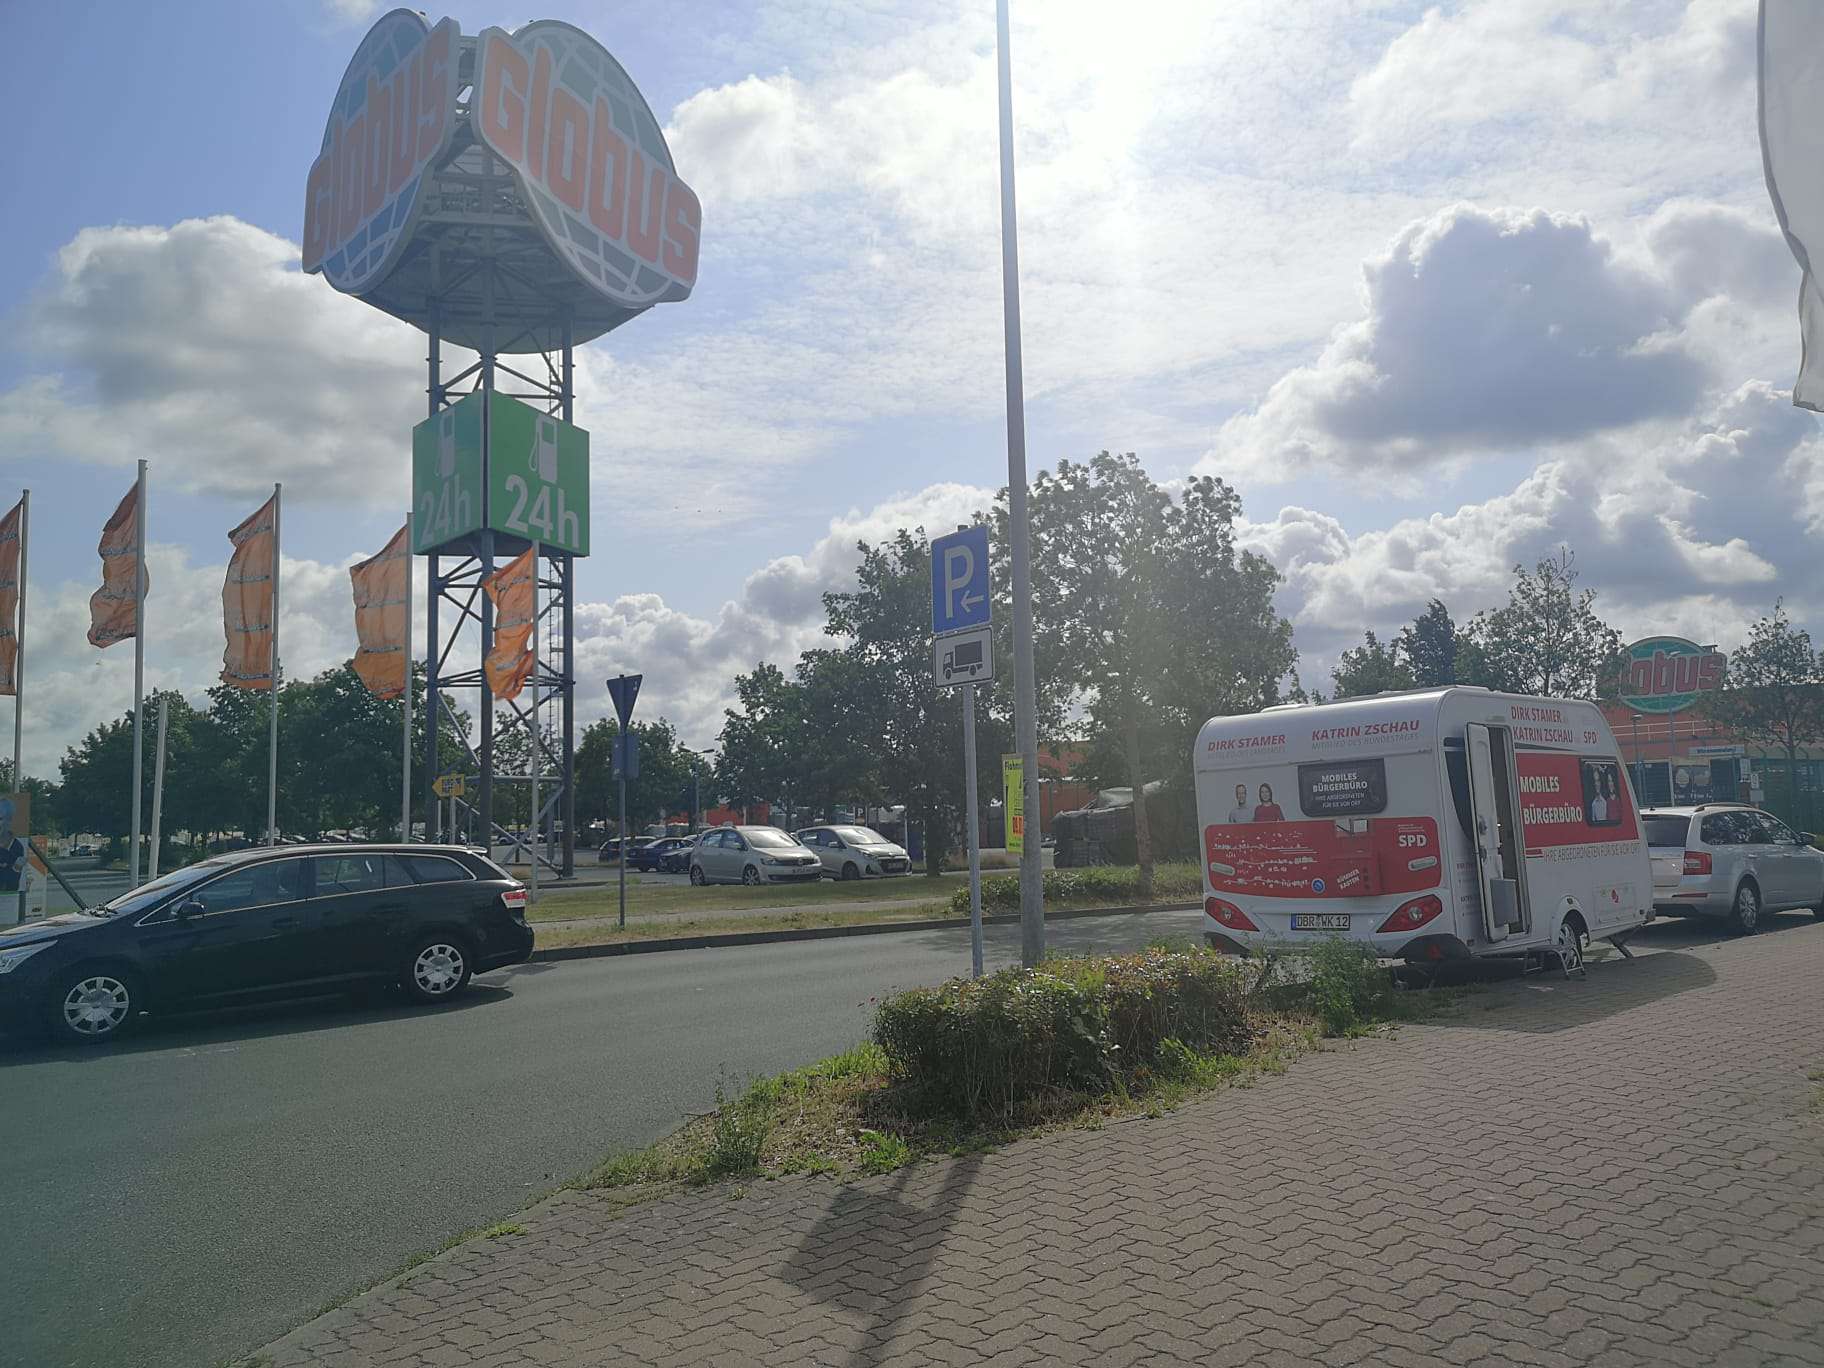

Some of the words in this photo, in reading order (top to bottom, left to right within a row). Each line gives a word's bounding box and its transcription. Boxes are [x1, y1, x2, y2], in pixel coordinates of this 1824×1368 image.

[304, 28, 450, 266] Globus
[484, 35, 696, 289] Globus
[420, 473, 472, 546] 24h
[505, 474, 579, 548] 24h
[944, 545, 974, 619] P
[1511, 705, 1530, 720] DIRK
[1532, 707, 1562, 723] STAMER
[1312, 726, 1361, 741] KATRIN
[1364, 720, 1420, 735] ZSCHAU
[1513, 726, 1543, 742] KATRIN
[1544, 728, 1573, 743] ZSCHAU
[1583, 731, 1598, 744] SPD
[1208, 739, 1235, 752] DIRK
[1236, 734, 1286, 748] STAMER
[1321, 772, 1358, 782] MOBILES
[1520, 776, 1560, 793] MOBILES
[1312, 780, 1368, 793] BÜRGERBÜRO
[1524, 802, 1583, 825] BÜRGERBÜRO
[1399, 834, 1427, 847] SPD
[1296, 915, 1315, 928] DBR
[1320, 915, 1335, 928] WK
[1336, 915, 1349, 928] 12
